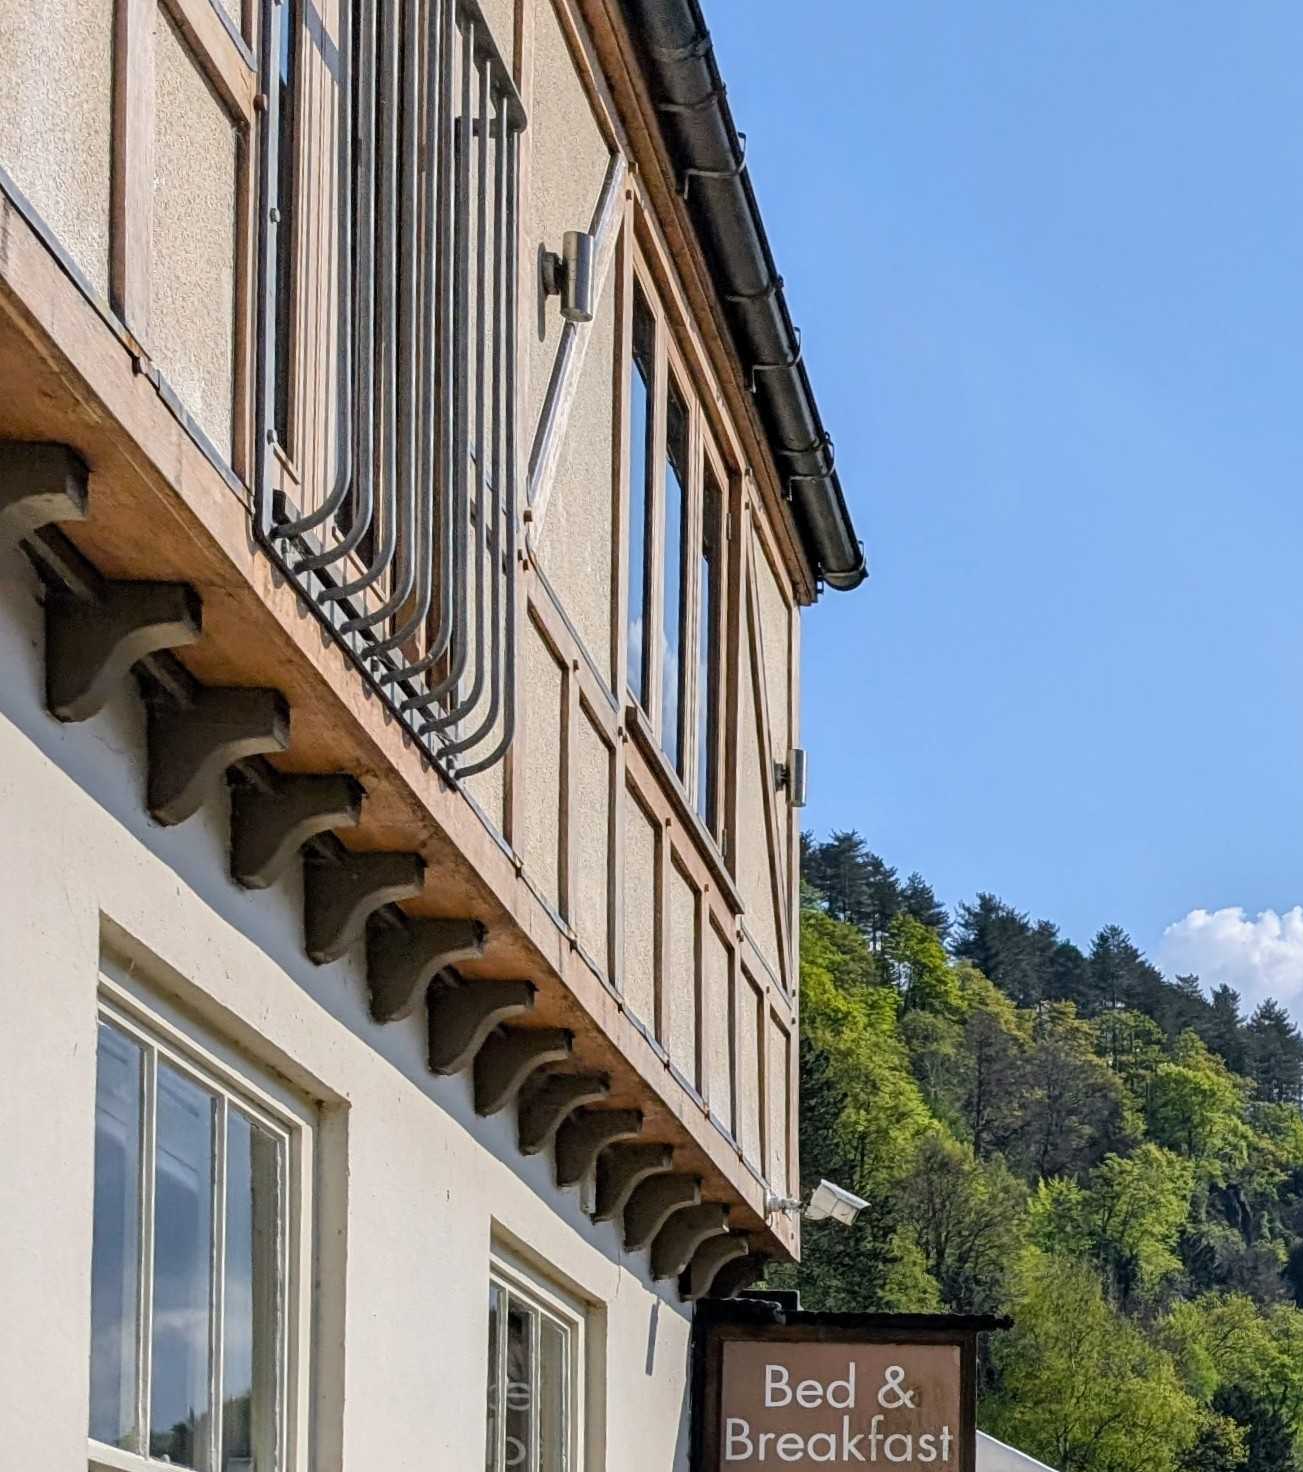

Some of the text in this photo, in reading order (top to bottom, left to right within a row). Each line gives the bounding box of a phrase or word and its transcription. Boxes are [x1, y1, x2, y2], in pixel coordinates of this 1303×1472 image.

[764, 1361, 915, 1409] Bed &
[724, 1414, 954, 1463] Breakfast
